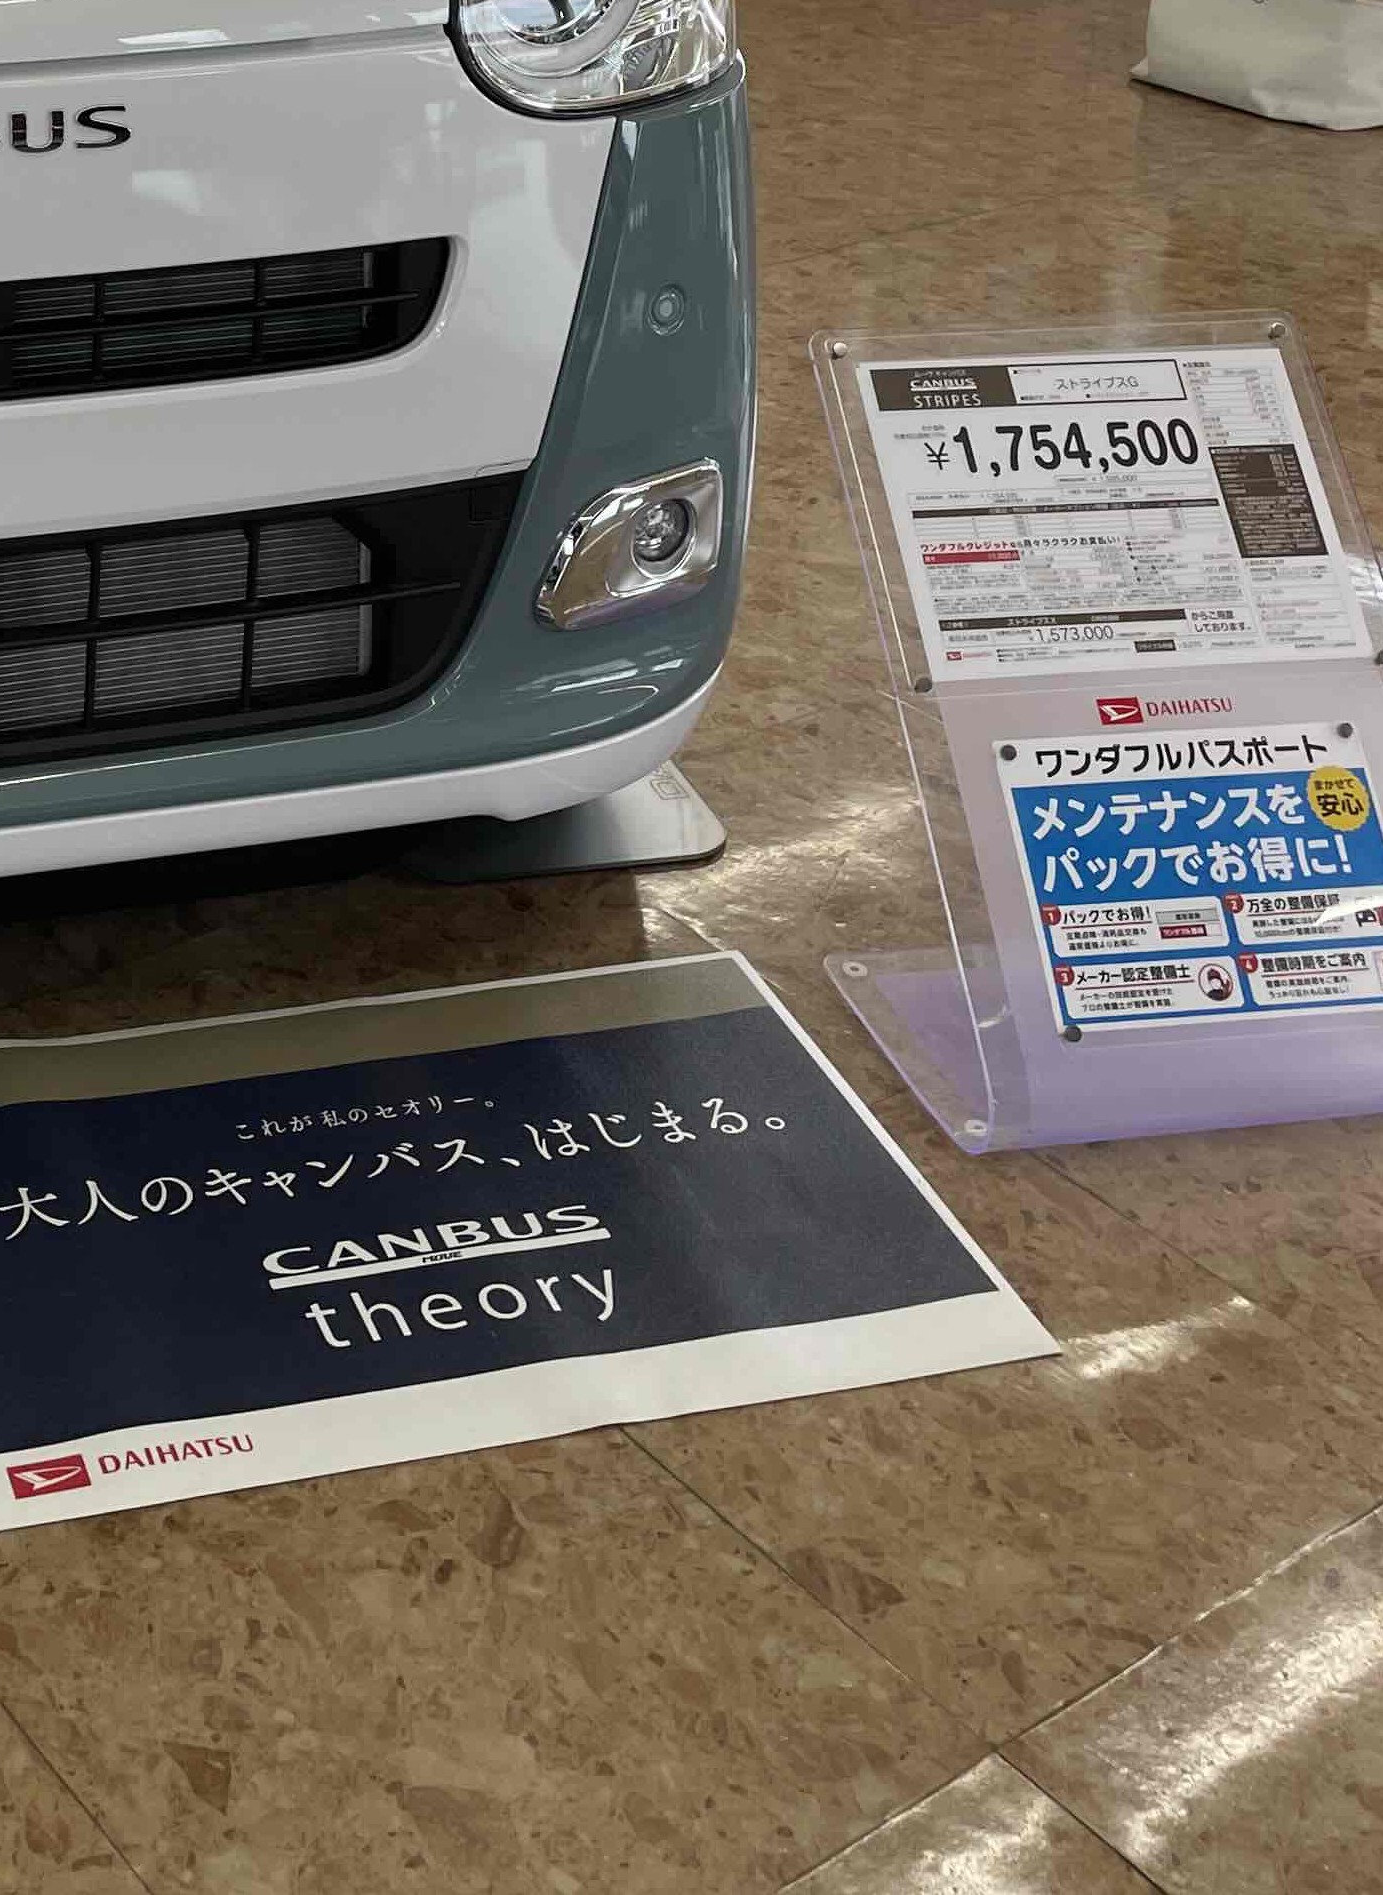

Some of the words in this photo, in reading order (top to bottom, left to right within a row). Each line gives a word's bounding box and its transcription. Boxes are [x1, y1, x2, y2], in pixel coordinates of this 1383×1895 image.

[910, 377, 977, 387] CANBUS
[913, 394, 982, 408] STRIPES
[1054, 376, 1139, 390] ストライプスG
[1145, 697, 1233, 717] DAIHATSU
[1036, 735, 1328, 778] ワンダフルパスポート
[1033, 783, 1305, 840] メンテナンスを
[1316, 792, 1364, 817] 安心
[1043, 833, 1352, 892] パックでお得に!
[1063, 907, 1151, 924] パックでお得!
[235, 1094, 495, 1142] これが私のセオリー。
[0, 1096, 789, 1240] 大人のキャンバス、はじまる。
[262, 1204, 602, 1278] CANBUS
[422, 1250, 462, 1263] MOVE
[306, 1264, 618, 1350] theory
[98, 1434, 254, 1475] DAIHATSU
